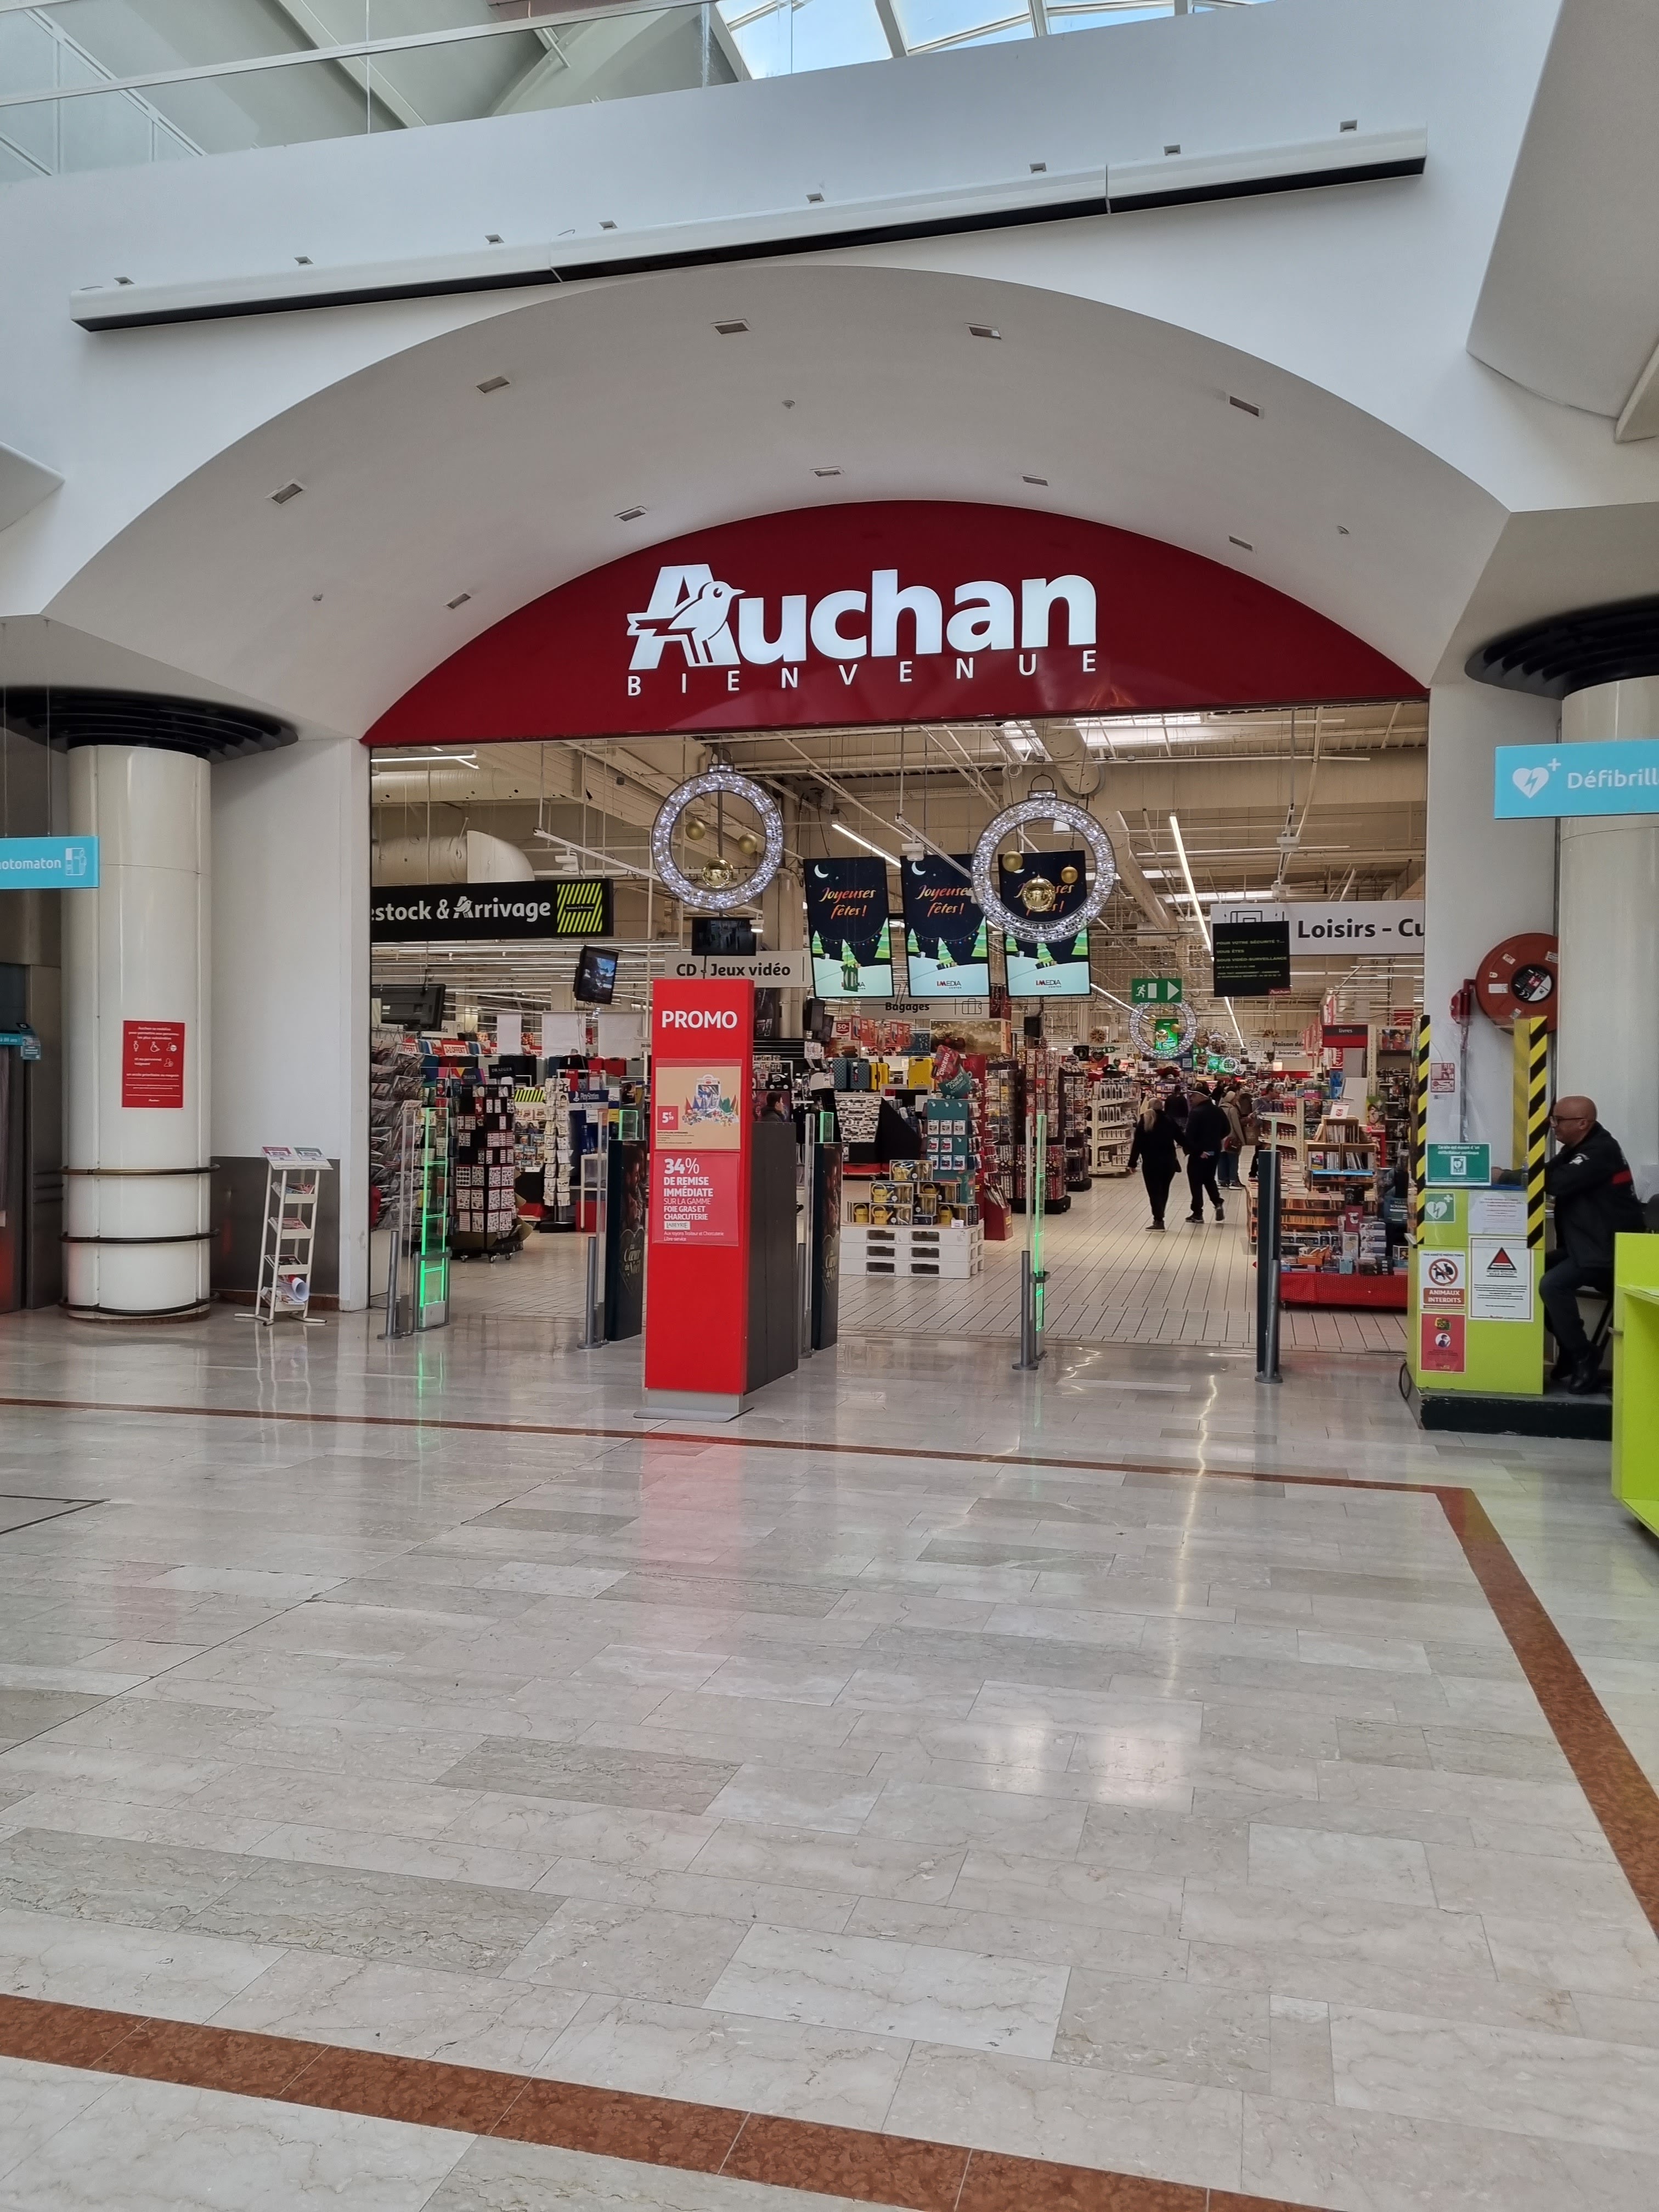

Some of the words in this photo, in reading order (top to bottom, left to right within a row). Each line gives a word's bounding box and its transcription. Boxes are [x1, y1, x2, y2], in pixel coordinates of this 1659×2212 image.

[627, 563, 1097, 670] Auchan
[628, 650, 1097, 697] BIENVENUE
[819, 887, 877, 904] Joyeuses
[436, 899, 449, 919] &
[453, 895, 551, 922] Arrivage
[1297, 918, 1376, 939] Loisirs
[676, 963, 697, 977] CD
[710, 963, 745, 977] Jeux
[748, 962, 791, 977] vidéo
[885, 1002, 930, 1013] Bagages
[661, 1010, 738, 1029] PROMO
[664, 1158, 700, 1175] 34%
[664, 1177, 676, 1186] DE
[676, 1177, 709, 1186] REMISE
[664, 1186, 714, 1197] IMMÉDIATE
